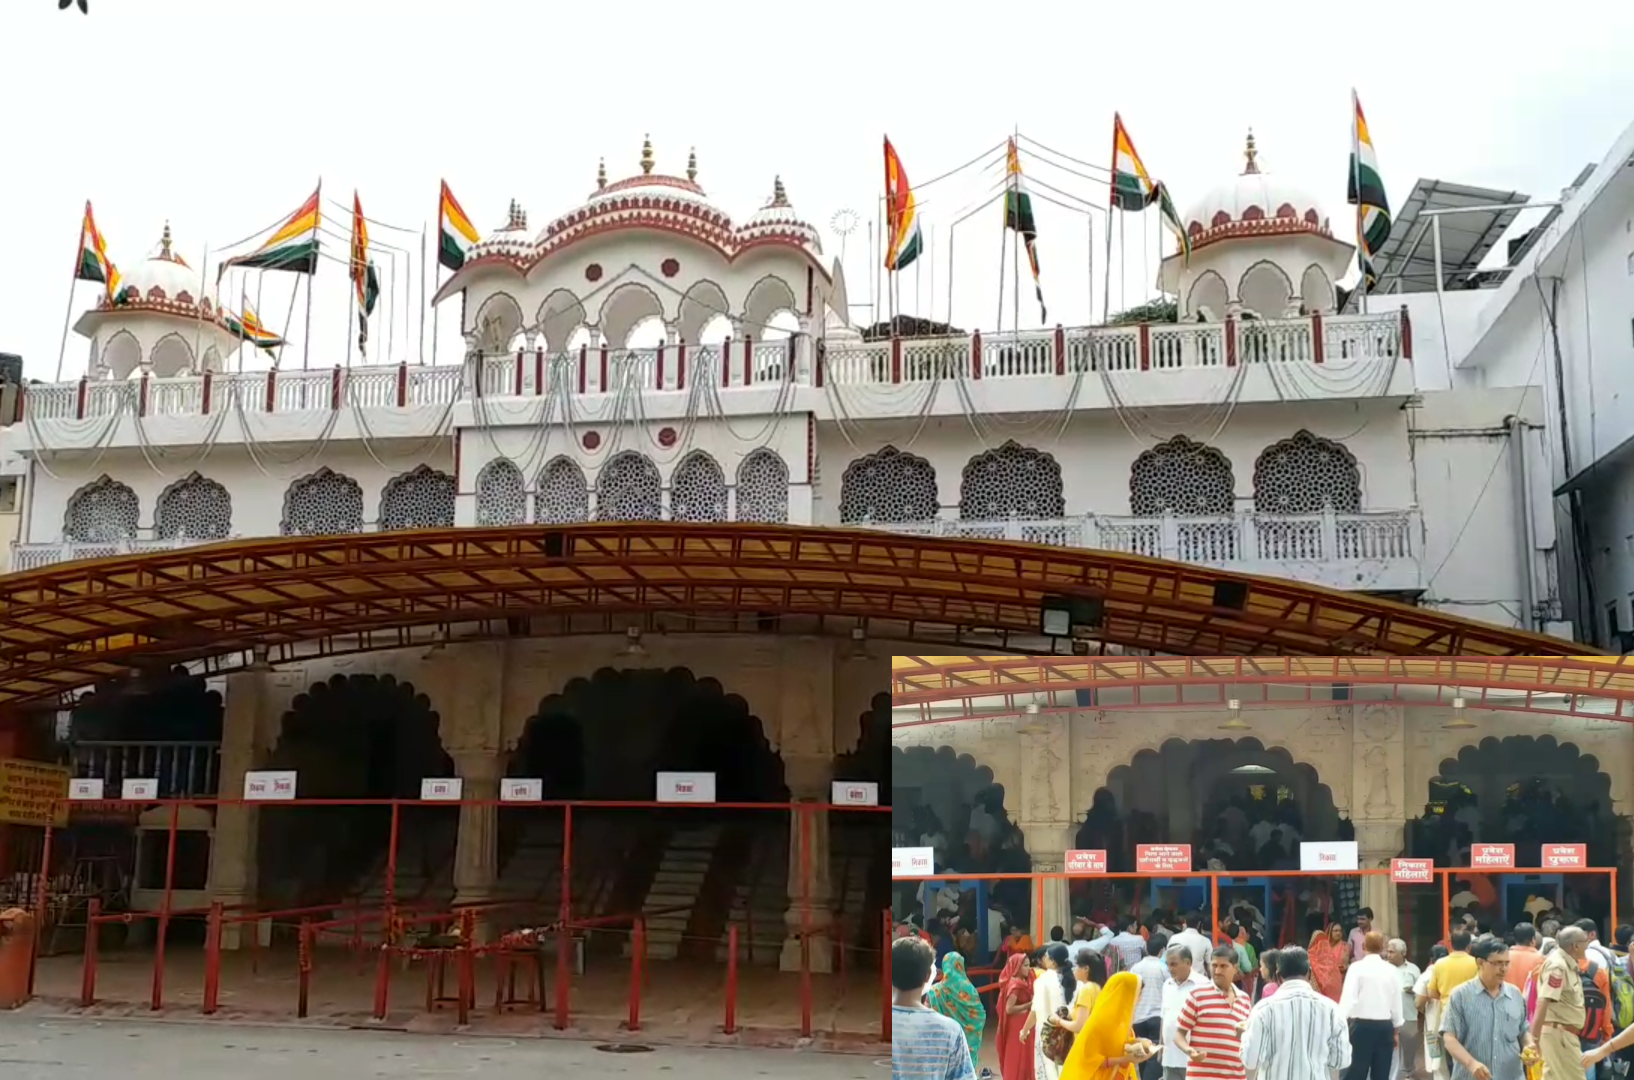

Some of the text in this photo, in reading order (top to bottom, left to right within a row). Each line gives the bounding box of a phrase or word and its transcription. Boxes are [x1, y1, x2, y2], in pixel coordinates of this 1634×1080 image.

[1482, 846, 1504, 854] प्रवेश
[1552, 846, 1576, 854] प्रवेश
[1075, 851, 1097, 860] प्रवेश
